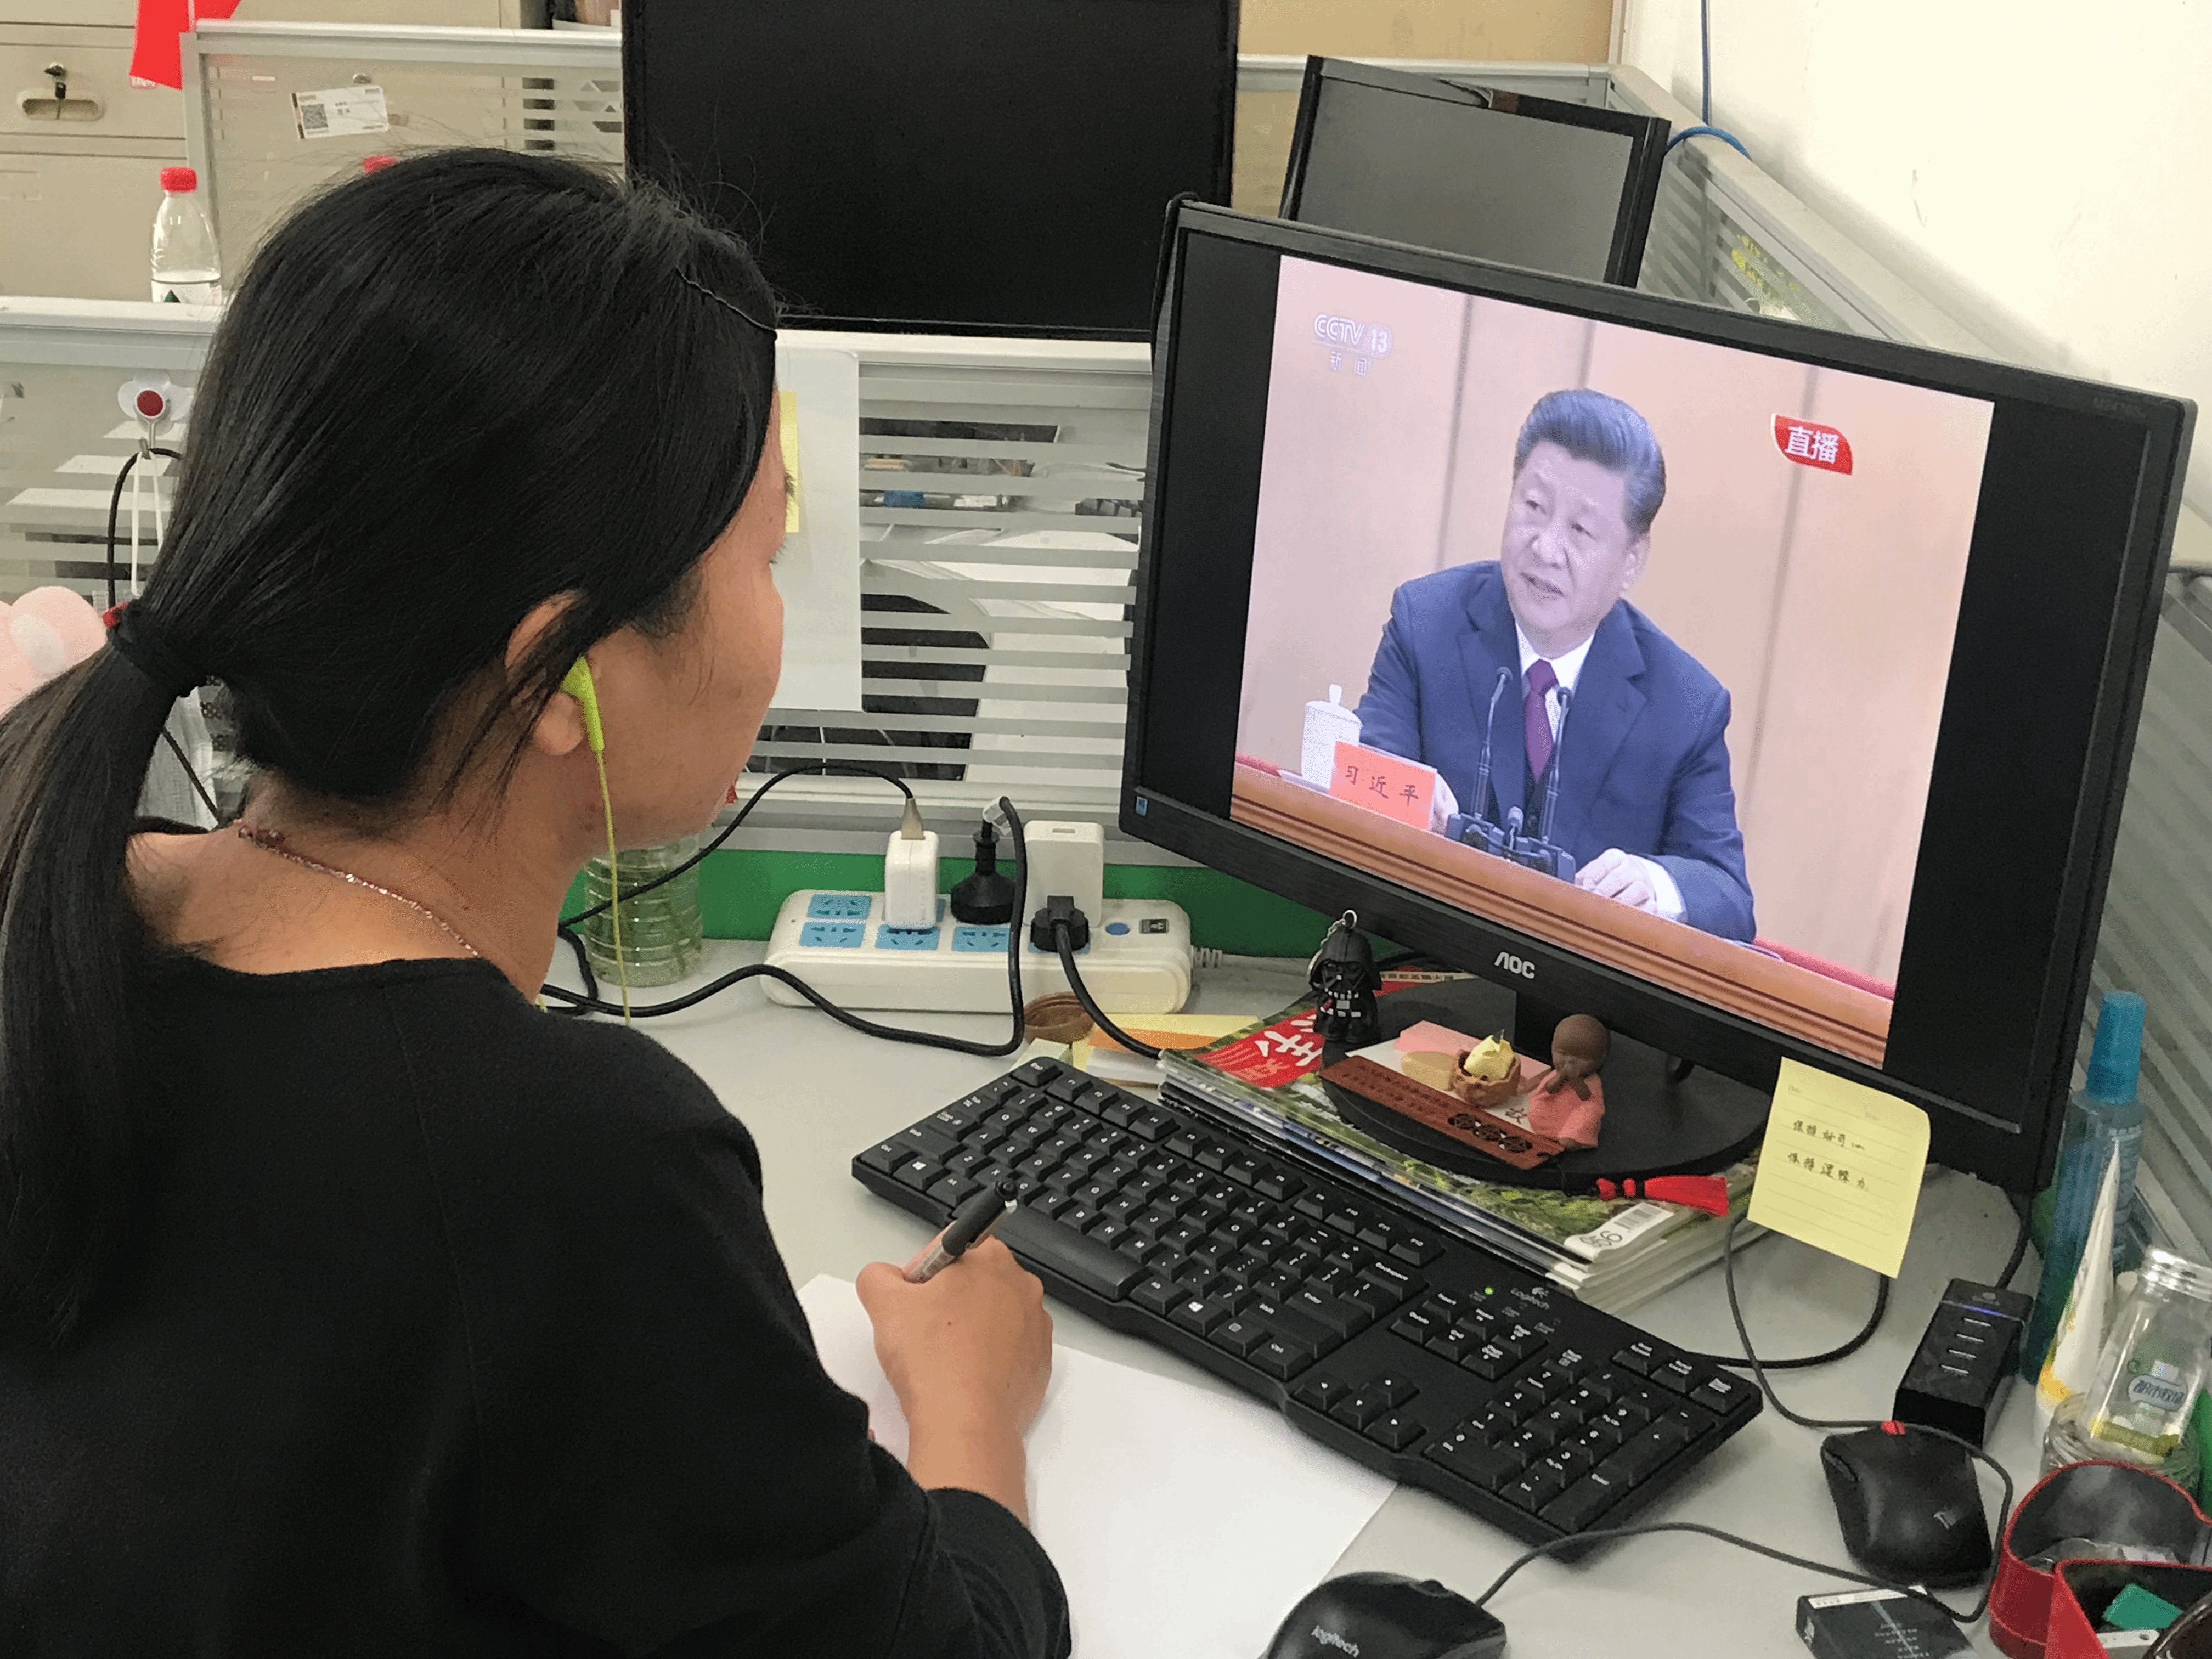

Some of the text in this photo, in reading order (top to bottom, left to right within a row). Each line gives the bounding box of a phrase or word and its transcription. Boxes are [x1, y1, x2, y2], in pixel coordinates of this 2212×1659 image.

[1314, 314, 1387, 352] CCTV 13
[1785, 426, 1838, 464] 直播
[1345, 765, 1419, 806] 习近平
[1494, 951, 1535, 979] AOC
